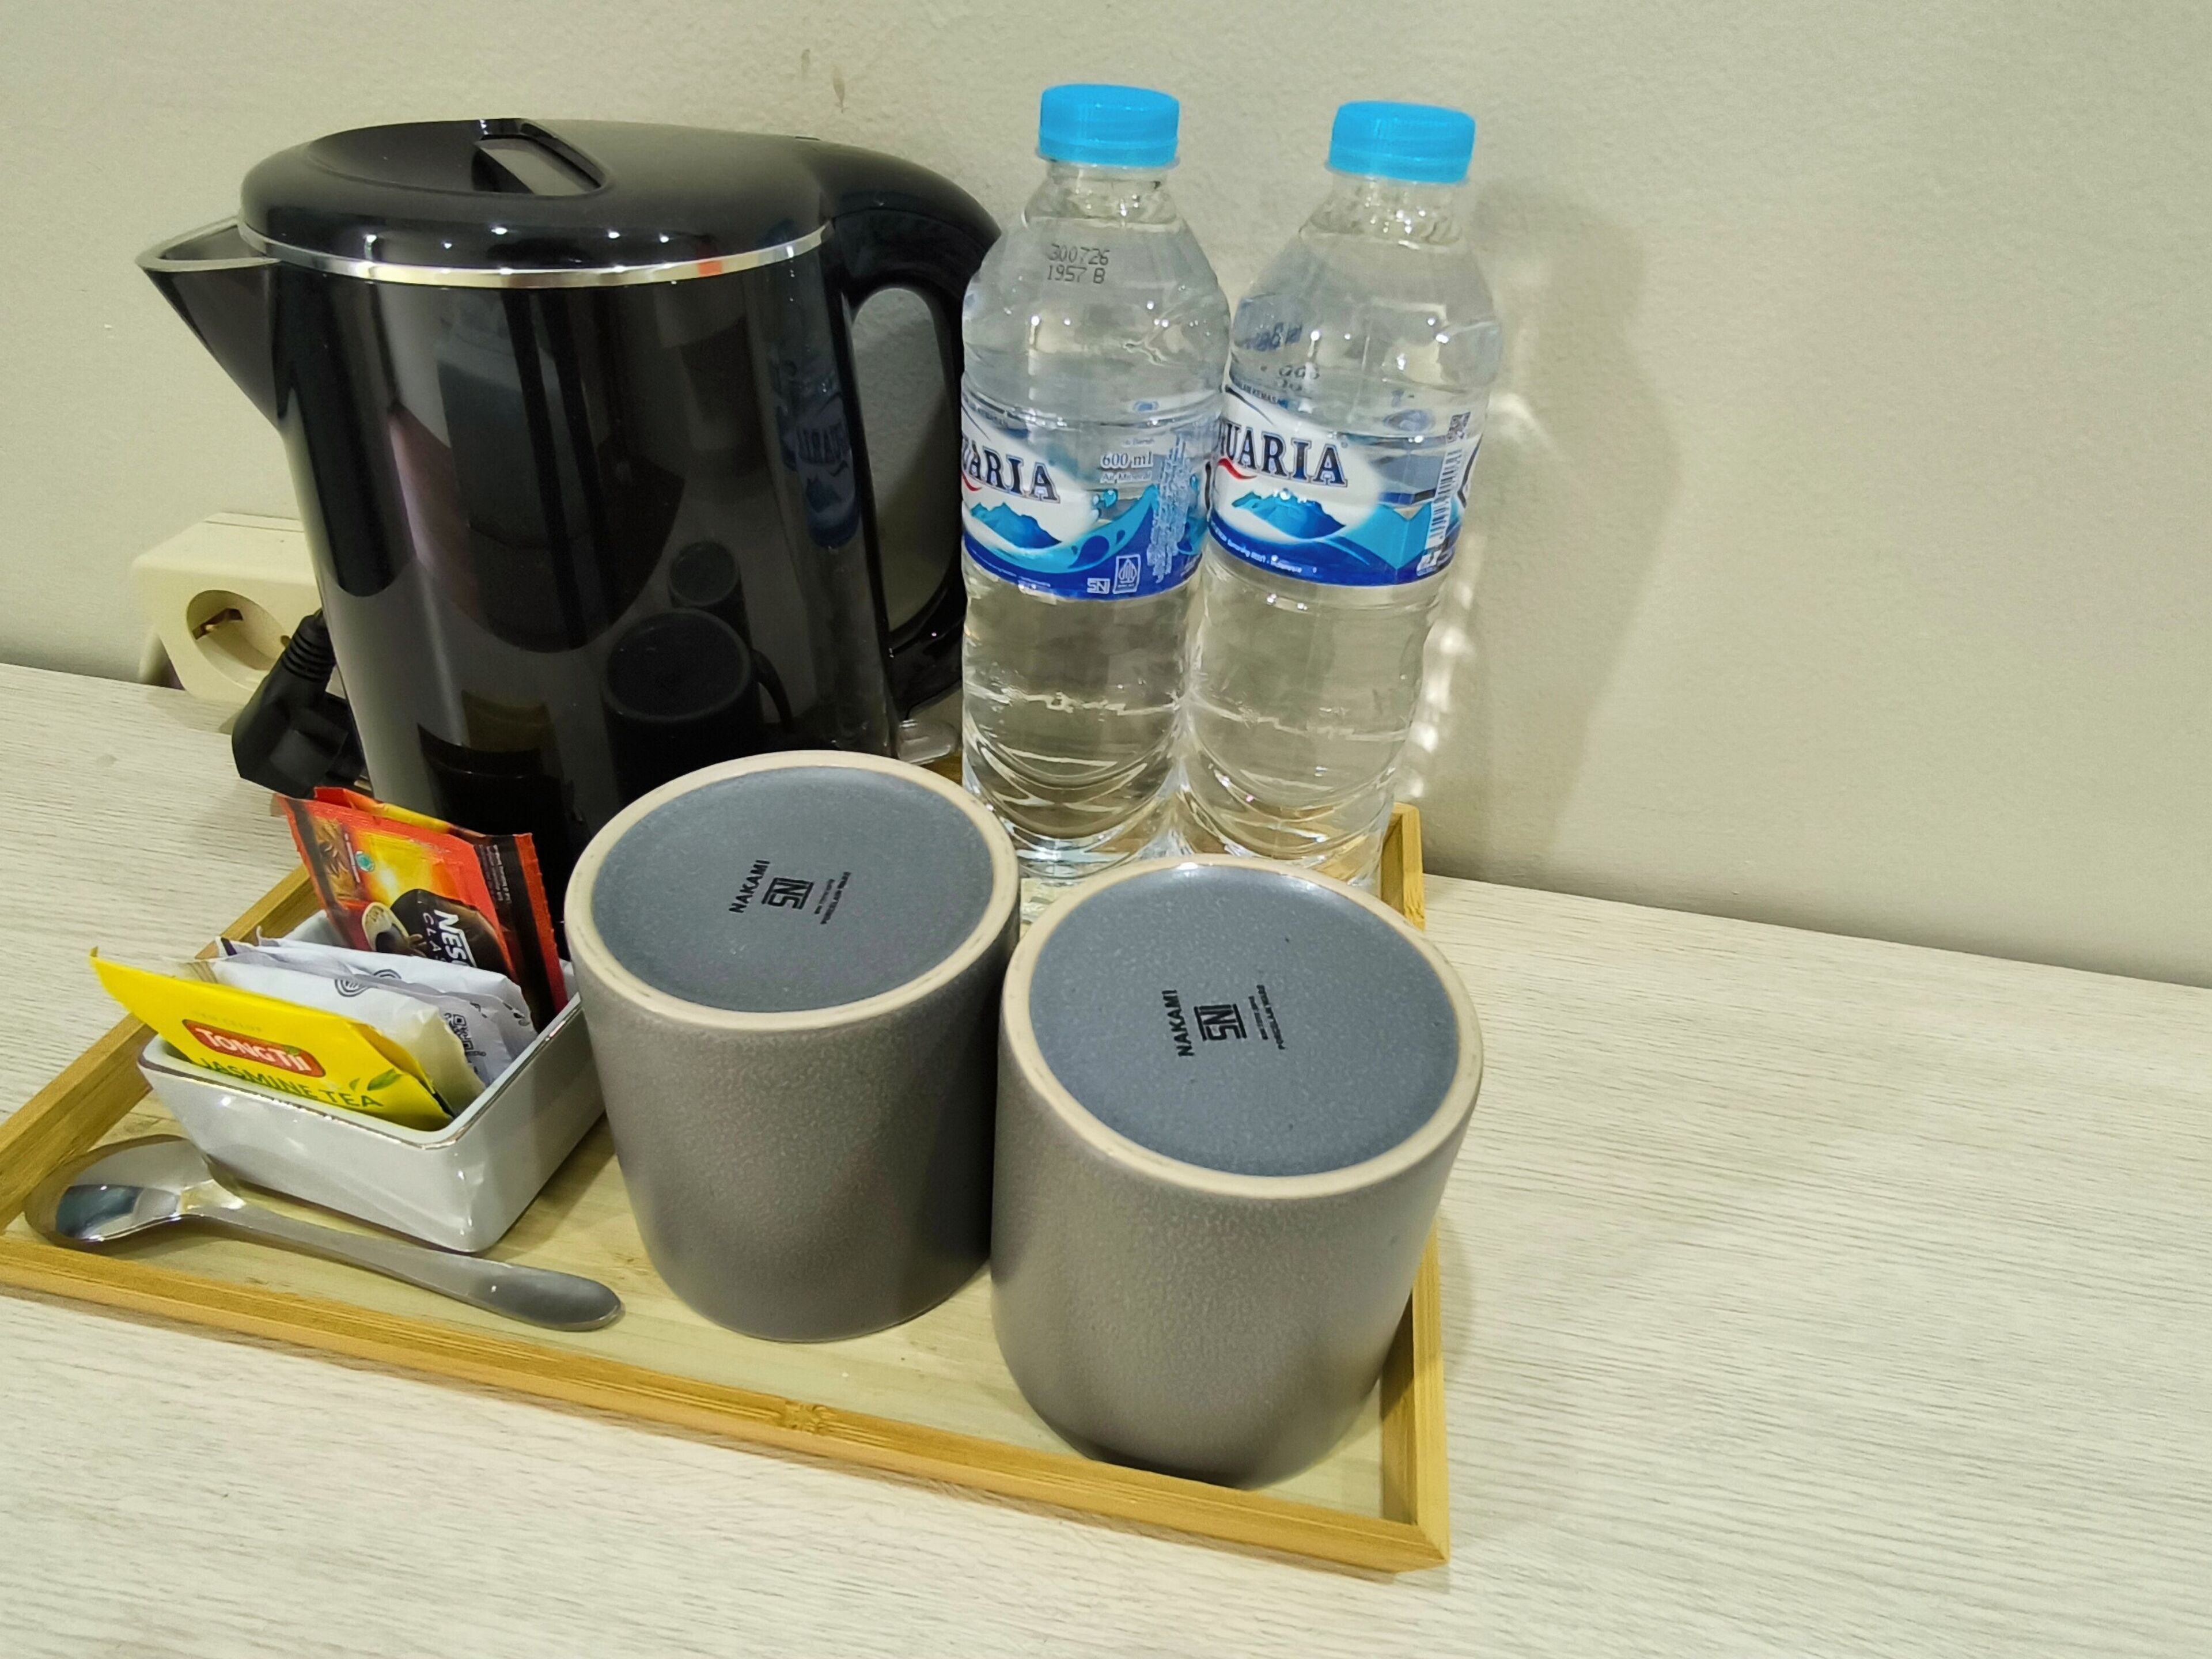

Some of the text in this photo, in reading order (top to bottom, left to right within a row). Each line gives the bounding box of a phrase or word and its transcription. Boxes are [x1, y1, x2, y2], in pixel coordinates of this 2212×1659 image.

[1047, 264, 1105, 284] 1957 B
[1101, 451, 1153, 468] 600 ml
[1219, 420, 1348, 487] UARIA
[729, 859, 770, 914] NAKAMI
[423, 912, 446, 961] CLA
[434, 909, 478, 968] NES
[1161, 989, 1195, 1057] NAKAMI
[319, 1089, 384, 1108] TEA
